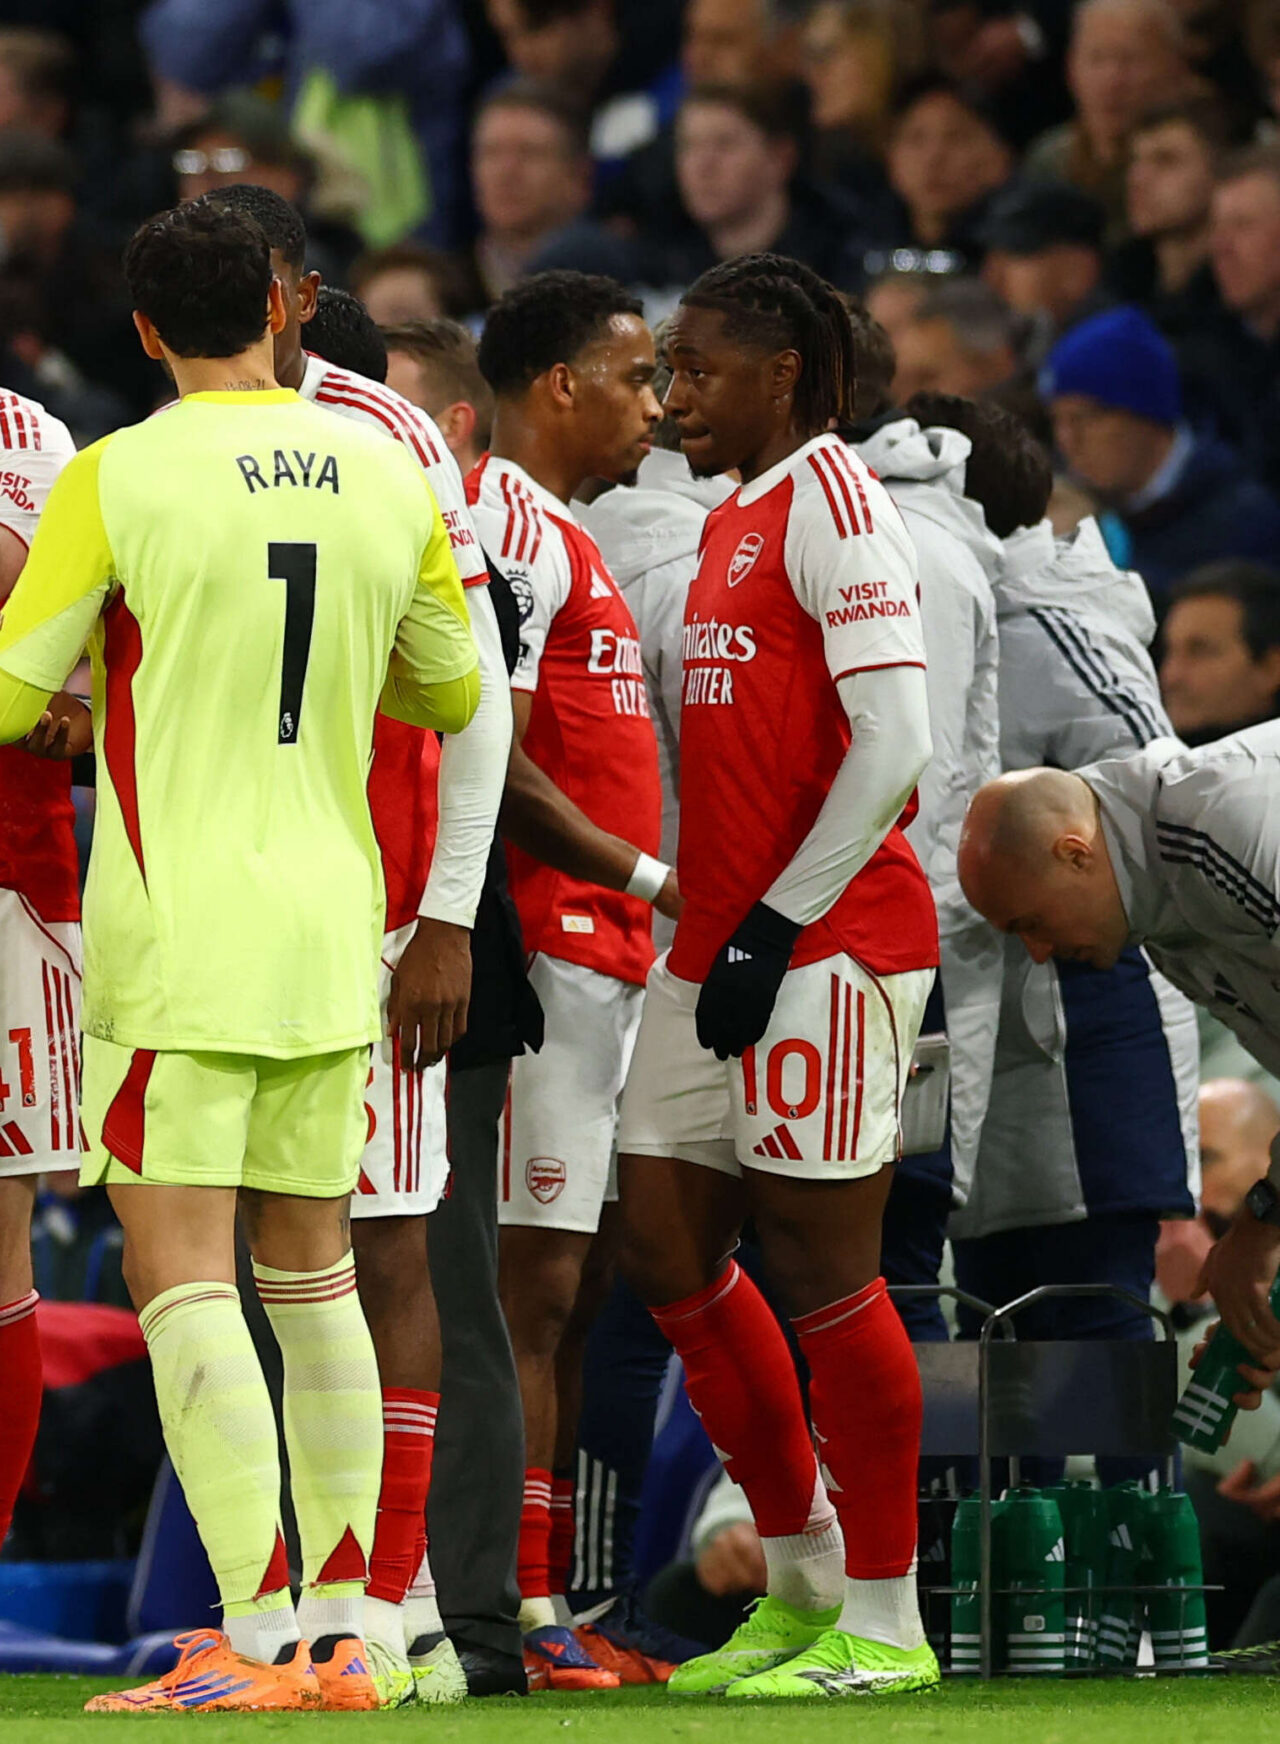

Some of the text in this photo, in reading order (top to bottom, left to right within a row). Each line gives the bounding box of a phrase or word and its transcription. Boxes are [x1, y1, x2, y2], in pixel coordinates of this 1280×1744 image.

[236, 449, 339, 495] RAYA
[441, 510, 461, 530] SIT
[838, 581, 889, 601] VISIT
[682, 612, 757, 662] mirates
[826, 600, 911, 629] RWANDA
[267, 542, 317, 745] 1
[741, 1038, 822, 1120] 10
